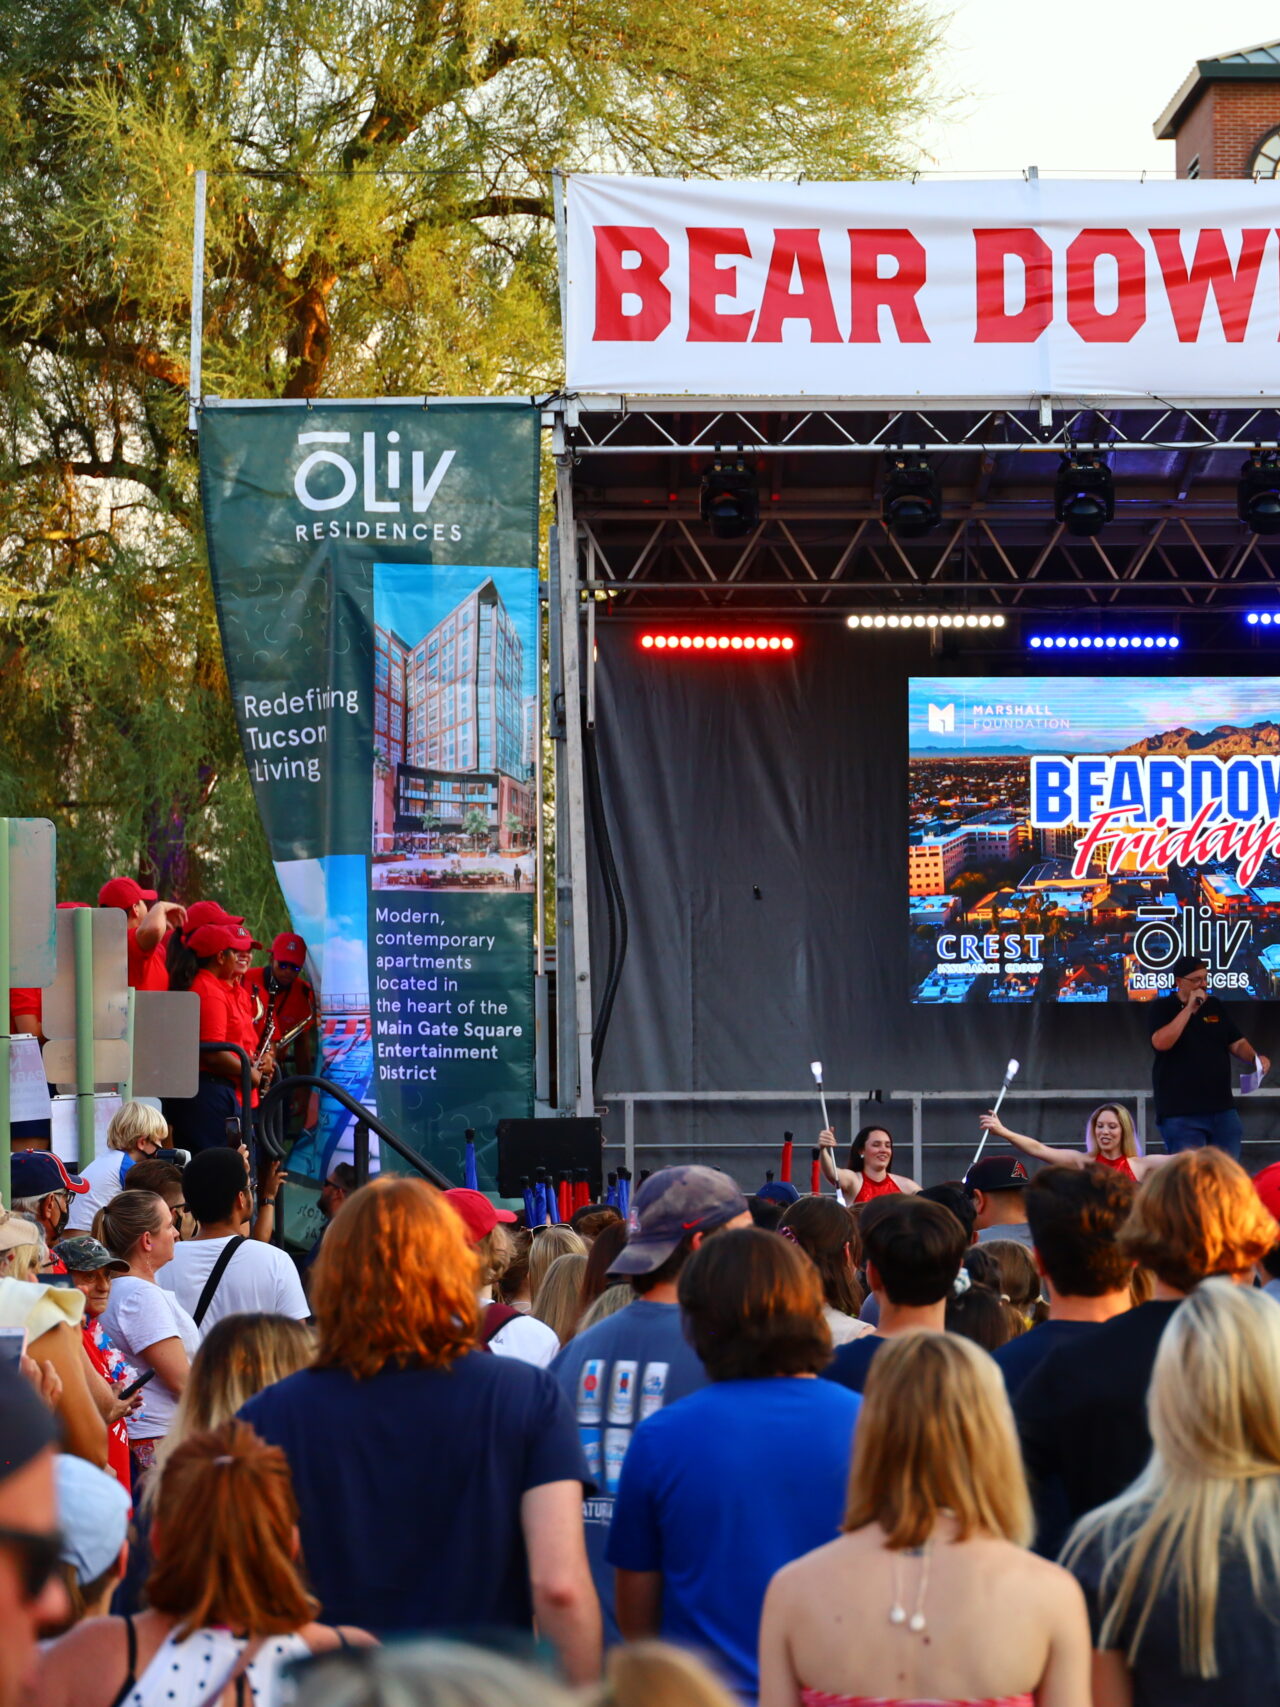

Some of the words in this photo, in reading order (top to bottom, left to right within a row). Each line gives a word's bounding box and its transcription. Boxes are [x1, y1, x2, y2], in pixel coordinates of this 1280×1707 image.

[592, 225, 931, 343] BEAR
[296, 521, 462, 542] RESIDENCES
[973, 704, 1053, 715] MARSHALL
[973, 719, 1070, 729] FOUNDATION
[246, 726, 326, 750] Tucson
[255, 756, 321, 782] Living
[375, 907, 445, 926] Modern,
[376, 933, 495, 951] contemporary
[937, 935, 1044, 962] CREST
[376, 954, 472, 971] apartments
[376, 976, 438, 991] located
[444, 977, 458, 991] in
[1133, 973, 1249, 988] RESICES
[376, 999, 401, 1013] the
[407, 998, 452, 1014] heart
[458, 1000, 475, 1014] of
[480, 1000, 508, 1014] the
[377, 1020, 412, 1035] Main
[418, 1021, 459, 1037] Gate
[464, 1022, 523, 1040] Square
[378, 1042, 498, 1060] Entertainment
[380, 1065, 437, 1080] District
